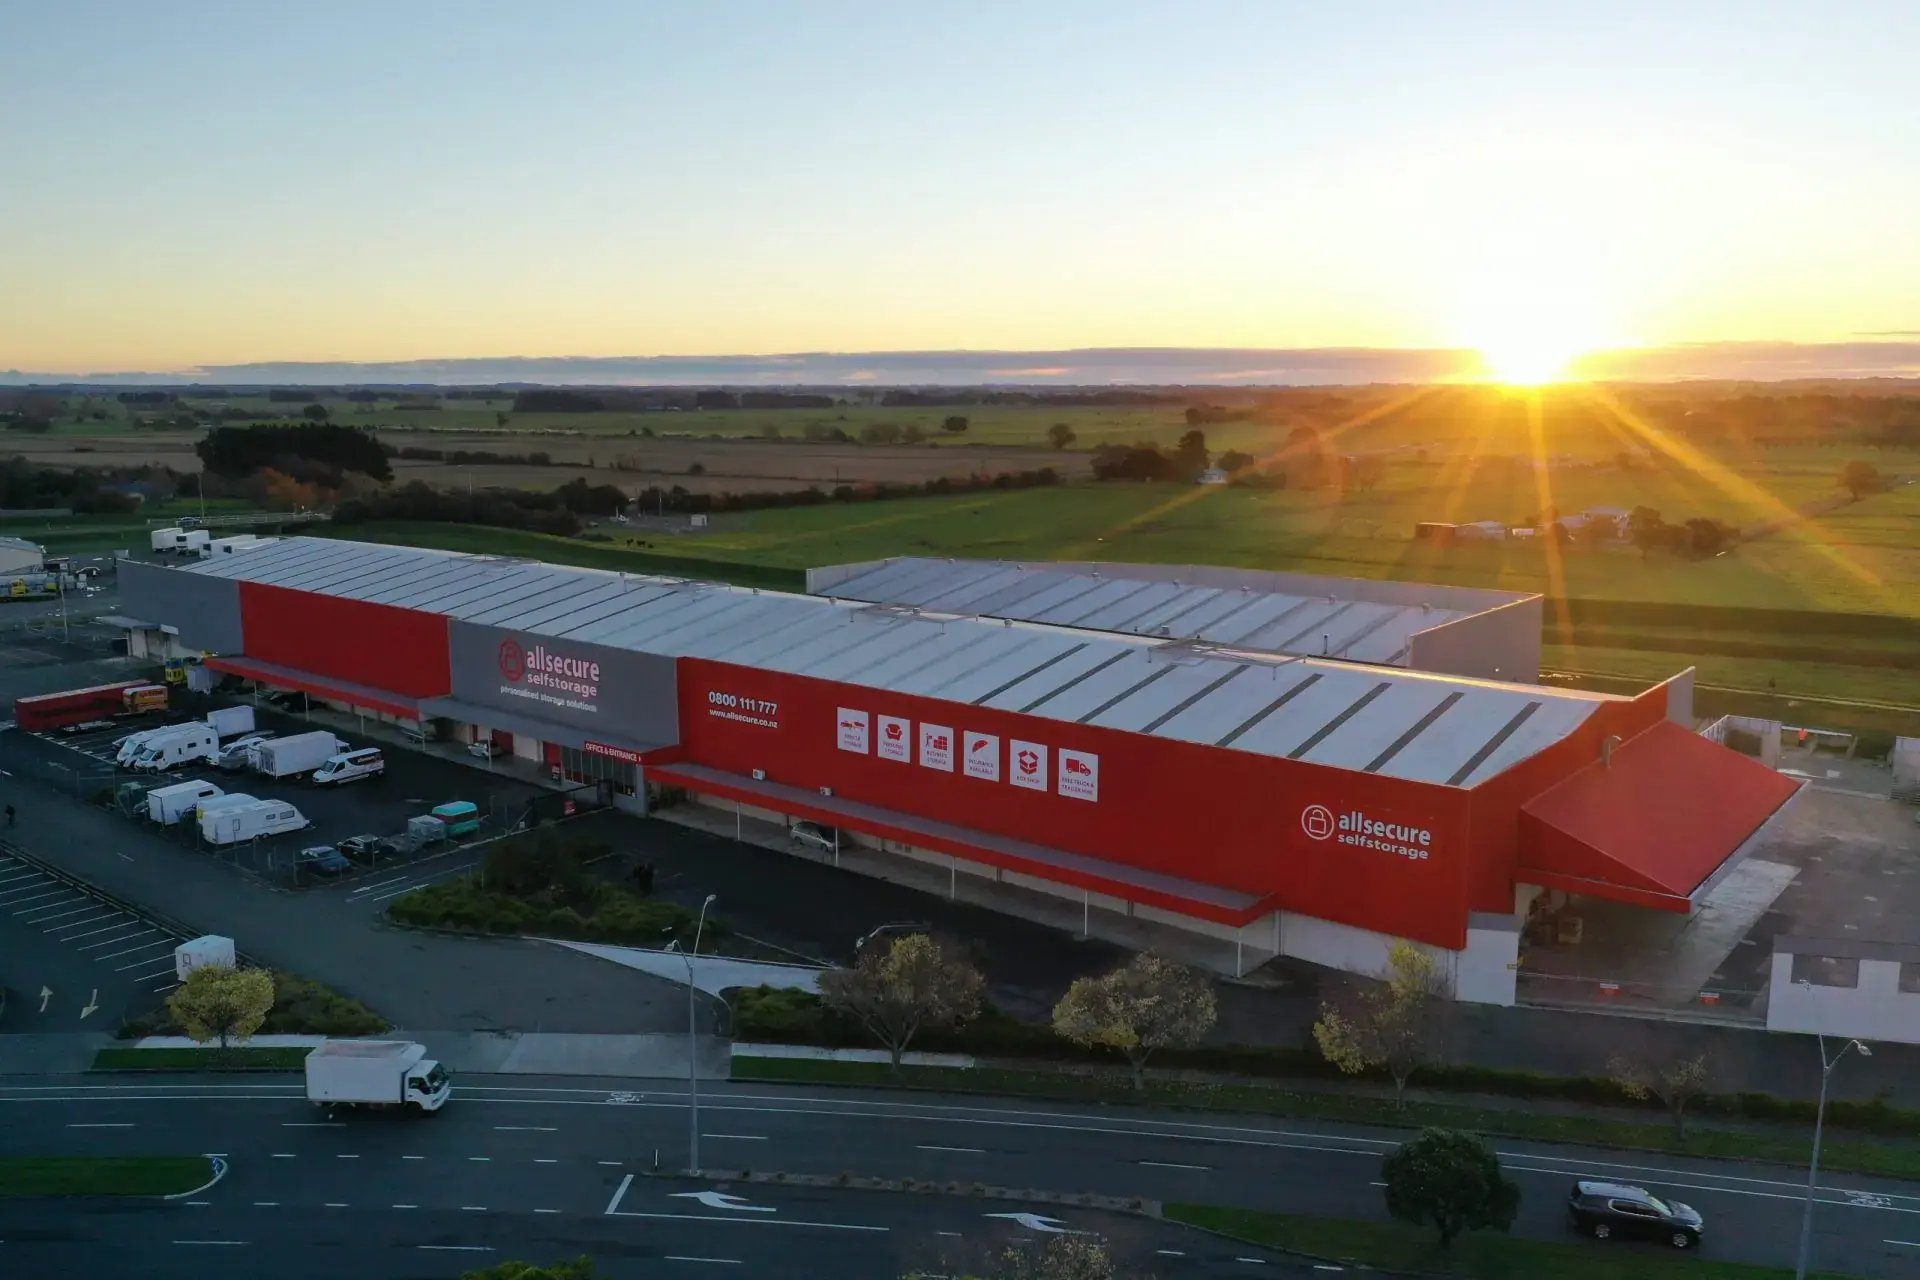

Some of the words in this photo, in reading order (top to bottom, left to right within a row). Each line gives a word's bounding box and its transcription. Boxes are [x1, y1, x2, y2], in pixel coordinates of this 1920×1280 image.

[527, 645, 600, 682] allsecure
[527, 672, 597, 698] selfstorage
[708, 691, 737, 708] 0800
[740, 697, 755, 711] 111
[758, 700, 778, 715] 777
[709, 709, 778, 728] www.allsecure.co.nz
[585, 743, 604, 754] OFFICE
[609, 748, 637, 762] ENTRANCE
[1338, 811, 1431, 846] allsecure
[1338, 834, 1429, 860] selfstorage
